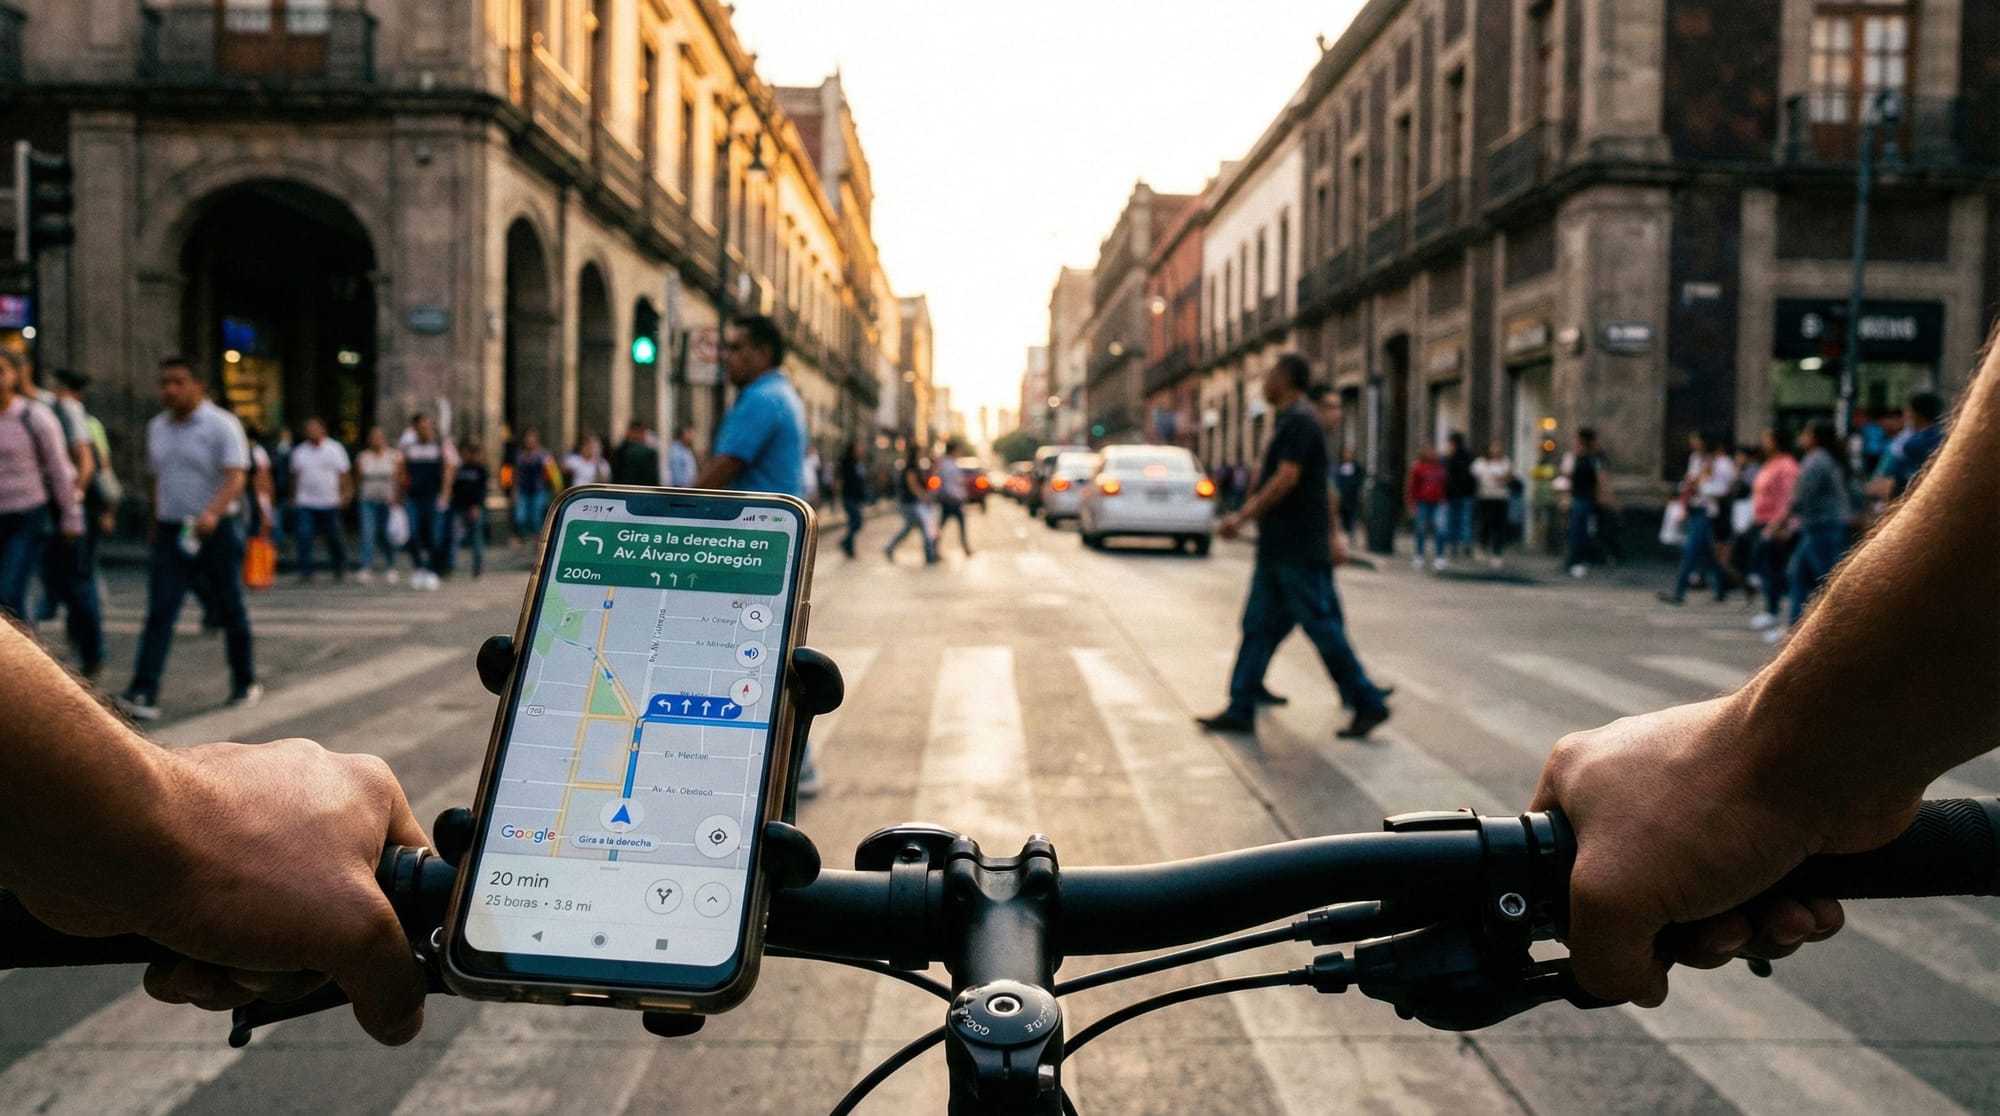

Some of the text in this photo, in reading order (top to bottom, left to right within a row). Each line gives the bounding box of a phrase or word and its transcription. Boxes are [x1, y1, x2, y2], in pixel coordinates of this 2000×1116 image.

[617, 529, 769, 550] Gira a la derecha en
[613, 545, 762, 568] Av. Álvaro Obregón
[563, 567, 601, 581] 200m
[501, 824, 556, 843] Google
[578, 835, 598, 845] Gira
[606, 837, 615, 846] la
[490, 871, 550, 889] 20 min
[485, 894, 502, 906] 25
[553, 899, 573, 911] 3.8
[576, 901, 592, 912] mi
